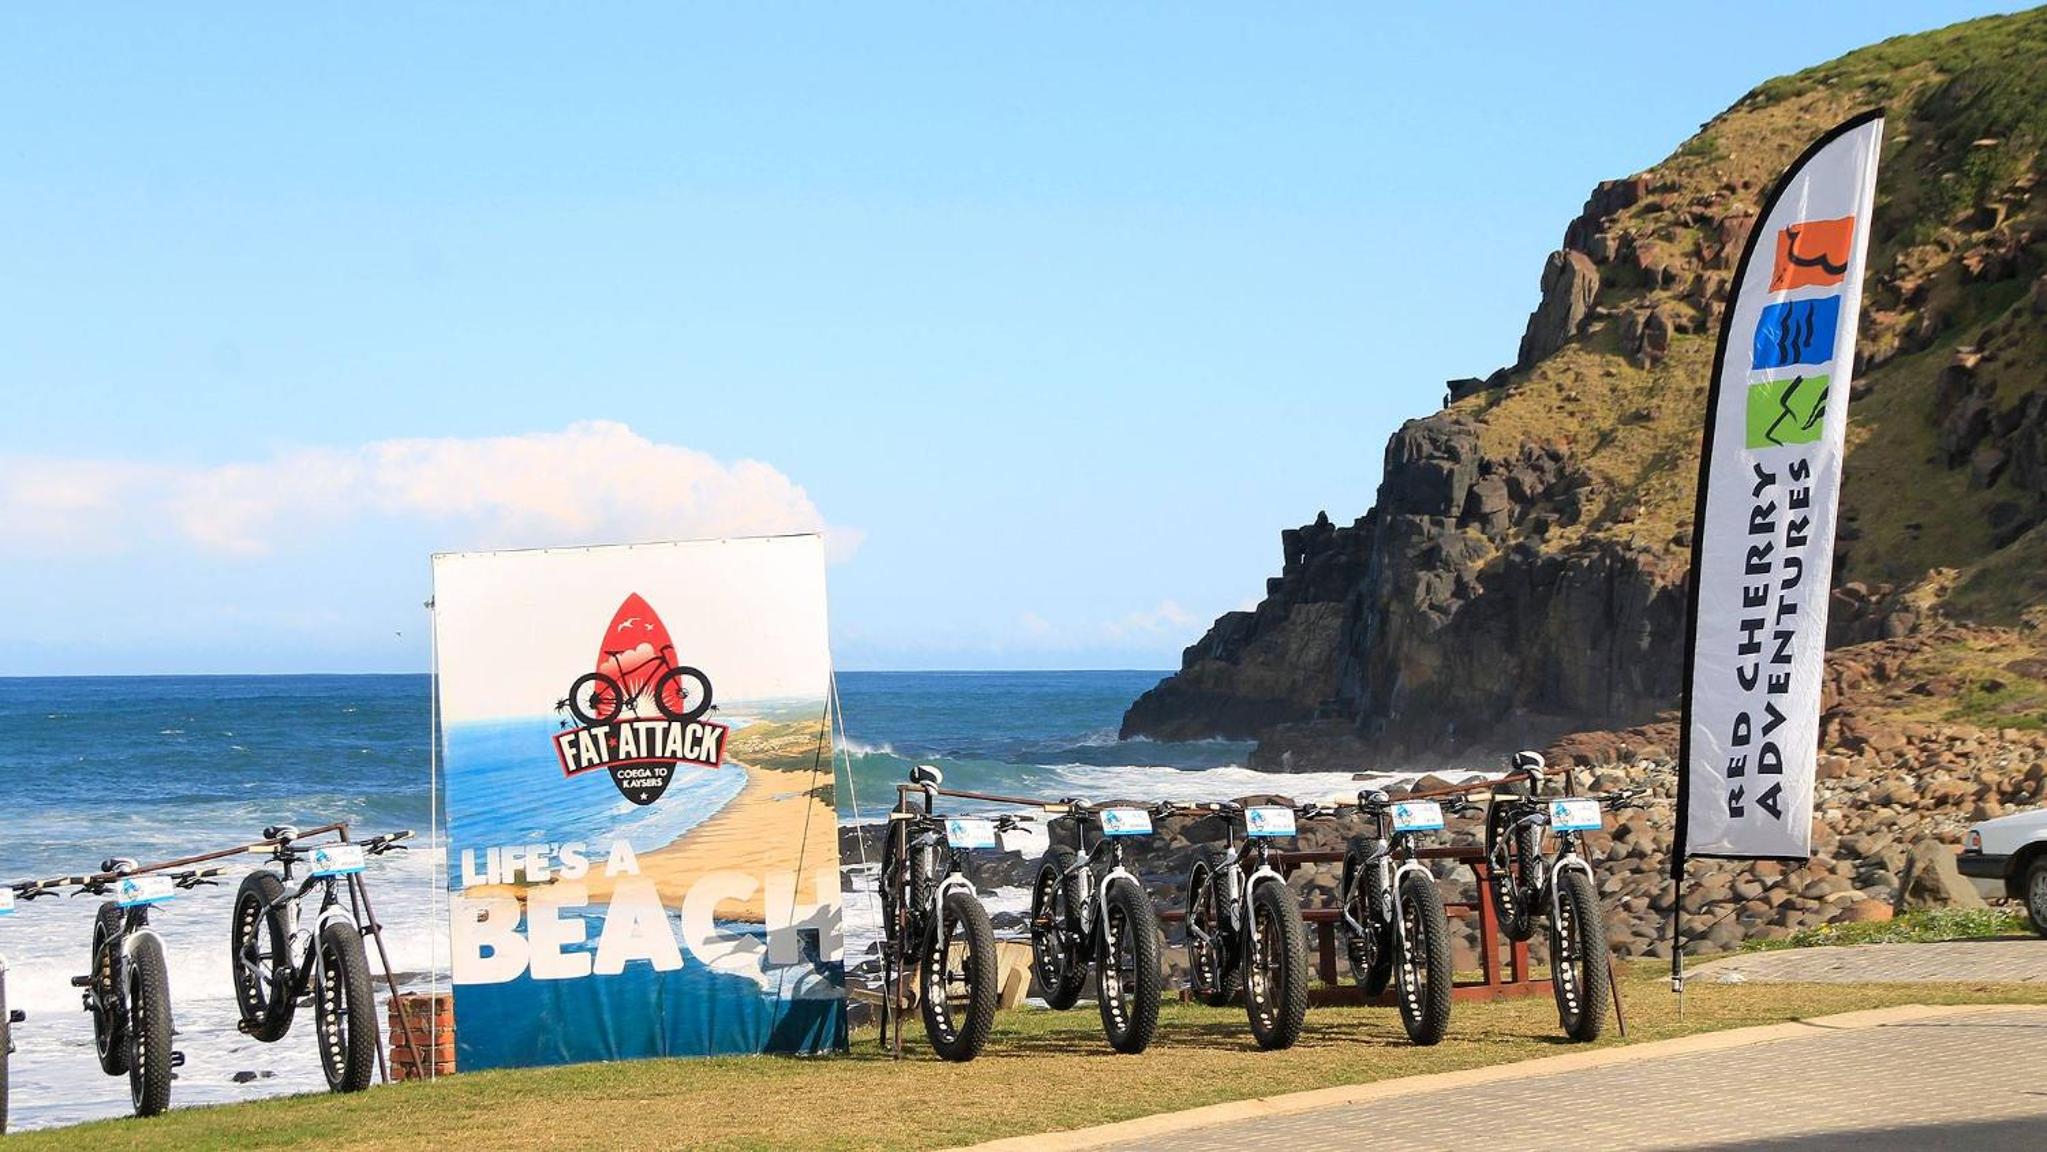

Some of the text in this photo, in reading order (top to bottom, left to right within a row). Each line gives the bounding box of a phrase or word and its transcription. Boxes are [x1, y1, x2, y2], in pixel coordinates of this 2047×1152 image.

[1727, 462, 1777, 818] RED CHERRY
[1756, 458, 1810, 821] ADVENTURES
[559, 721, 723, 772] FAT ATTACK
[617, 767, 668, 780] COEGA TO
[623, 778, 663, 788] KAYSERS
[461, 839, 641, 886] LIFE'S A
[450, 869, 844, 985] BEACH
